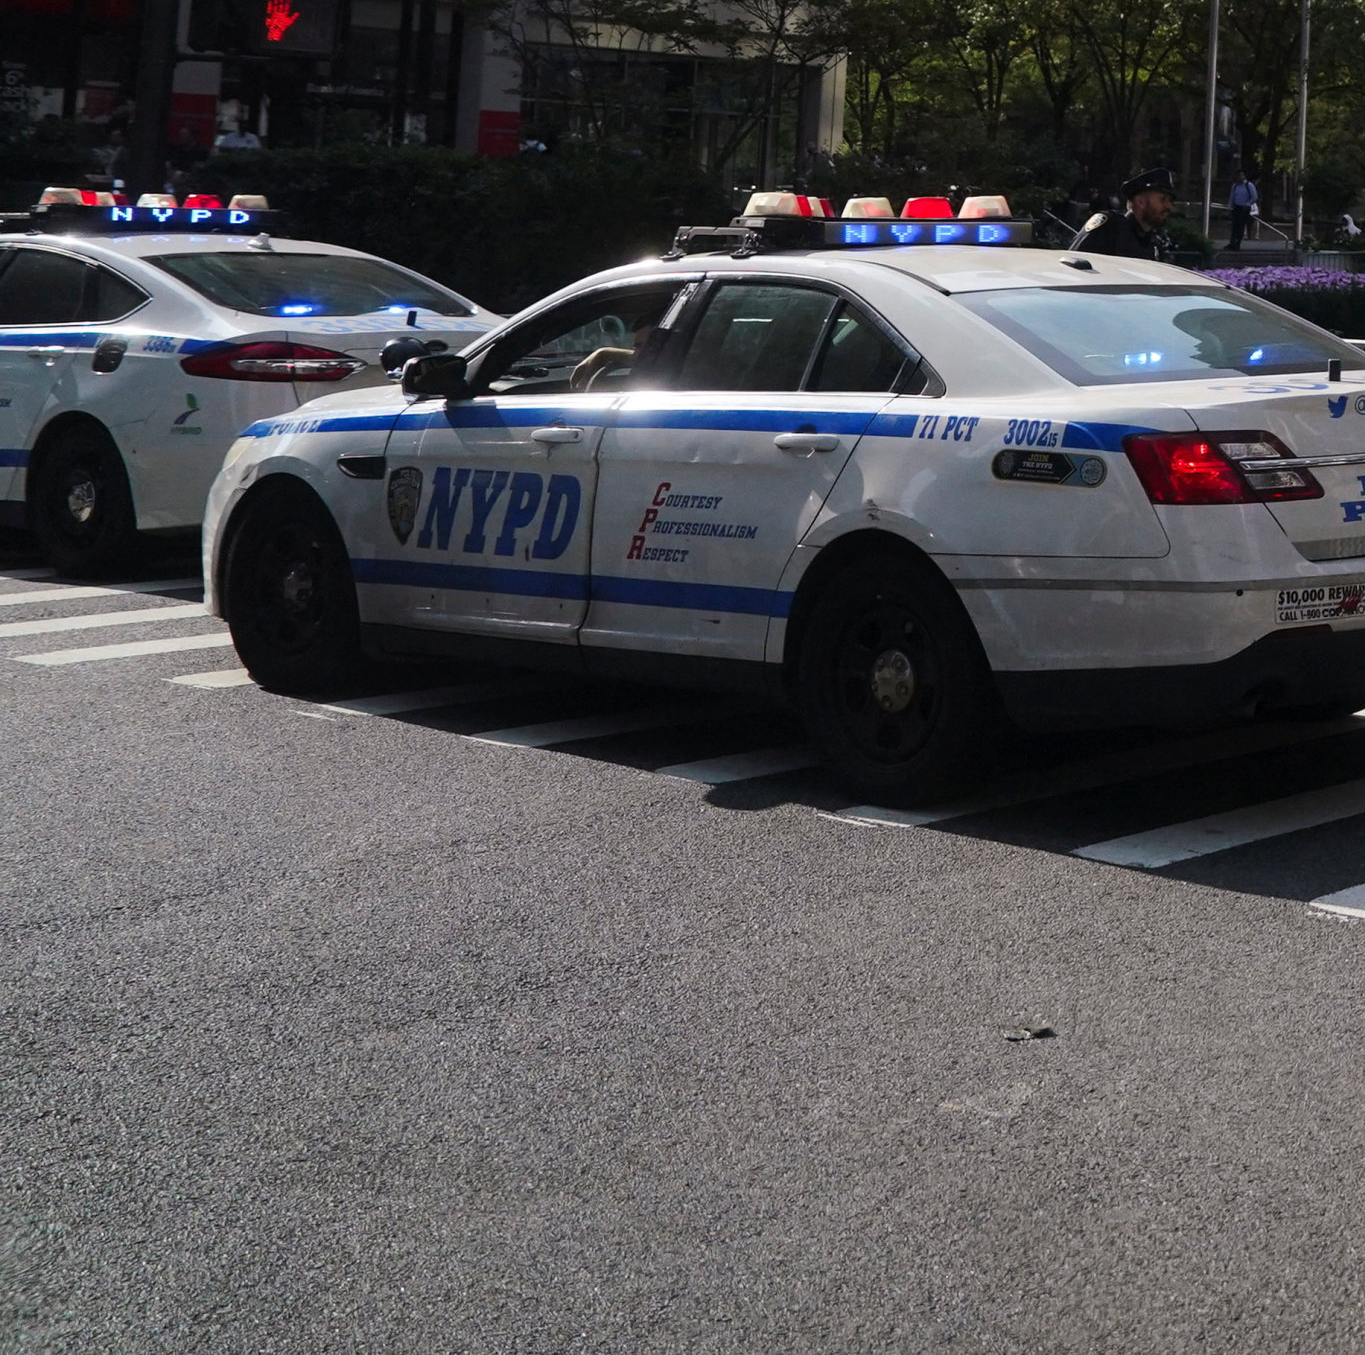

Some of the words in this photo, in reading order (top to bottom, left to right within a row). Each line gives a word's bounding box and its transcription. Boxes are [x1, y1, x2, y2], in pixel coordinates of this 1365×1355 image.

[111, 207, 250, 224] NYPD
[844, 224, 1000, 243] NYPD
[918, 415, 940, 439] 71
[941, 415, 981, 442] PCT
[1003, 419, 1051, 446] 3002
[1027, 453, 1049, 463] JOIN
[651, 481, 724, 510] COURTESY
[416, 466, 582, 560] NYPD
[638, 508, 759, 540] PROFESSIONALISM
[626, 535, 690, 563] RESPECT
[1278, 588, 1326, 606] $10,000
[1279, 611, 1298, 622] CALL
[1300, 608, 1320, 620] 1-800
